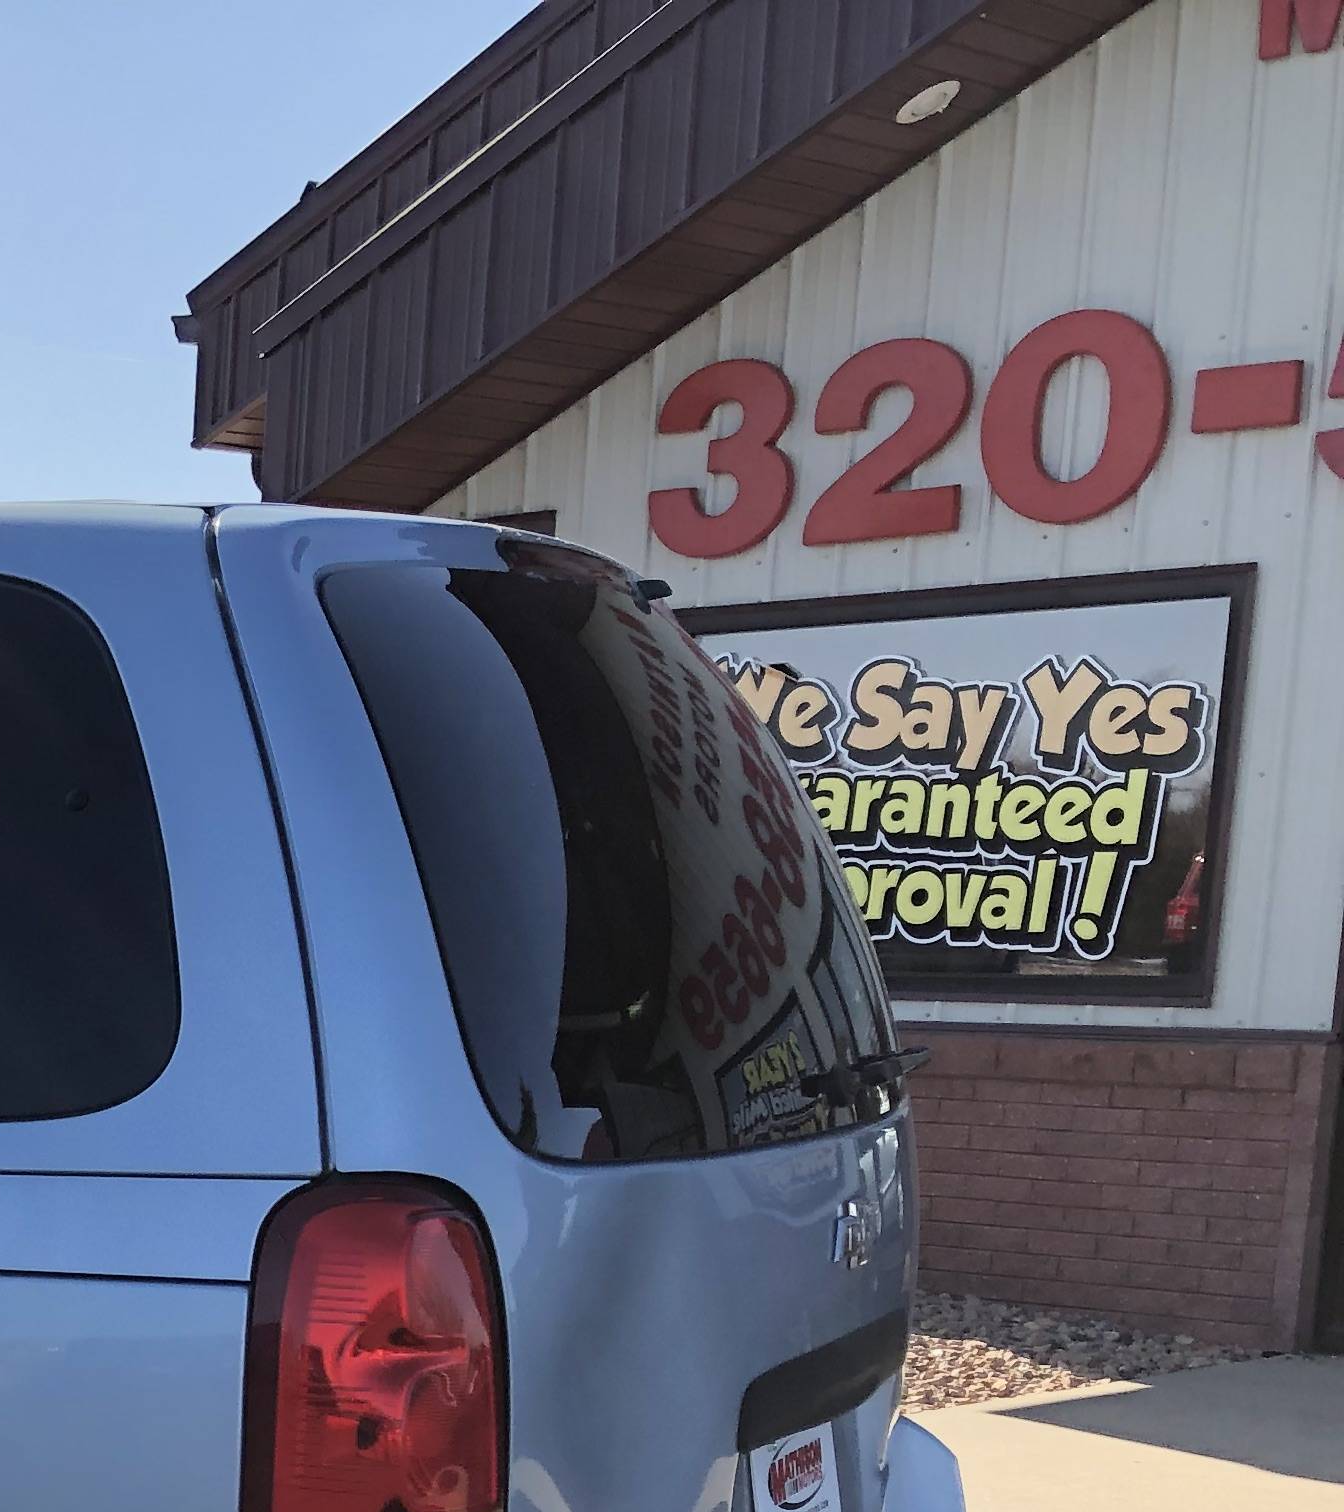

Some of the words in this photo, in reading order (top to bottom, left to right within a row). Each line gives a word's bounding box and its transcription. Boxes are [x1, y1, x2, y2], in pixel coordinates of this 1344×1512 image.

[648, 308, 1344, 559] 320-
[846, 657, 1010, 771] Say
[1021, 657, 1195, 757] Yes
[803, 767, 1150, 847] aranteed
